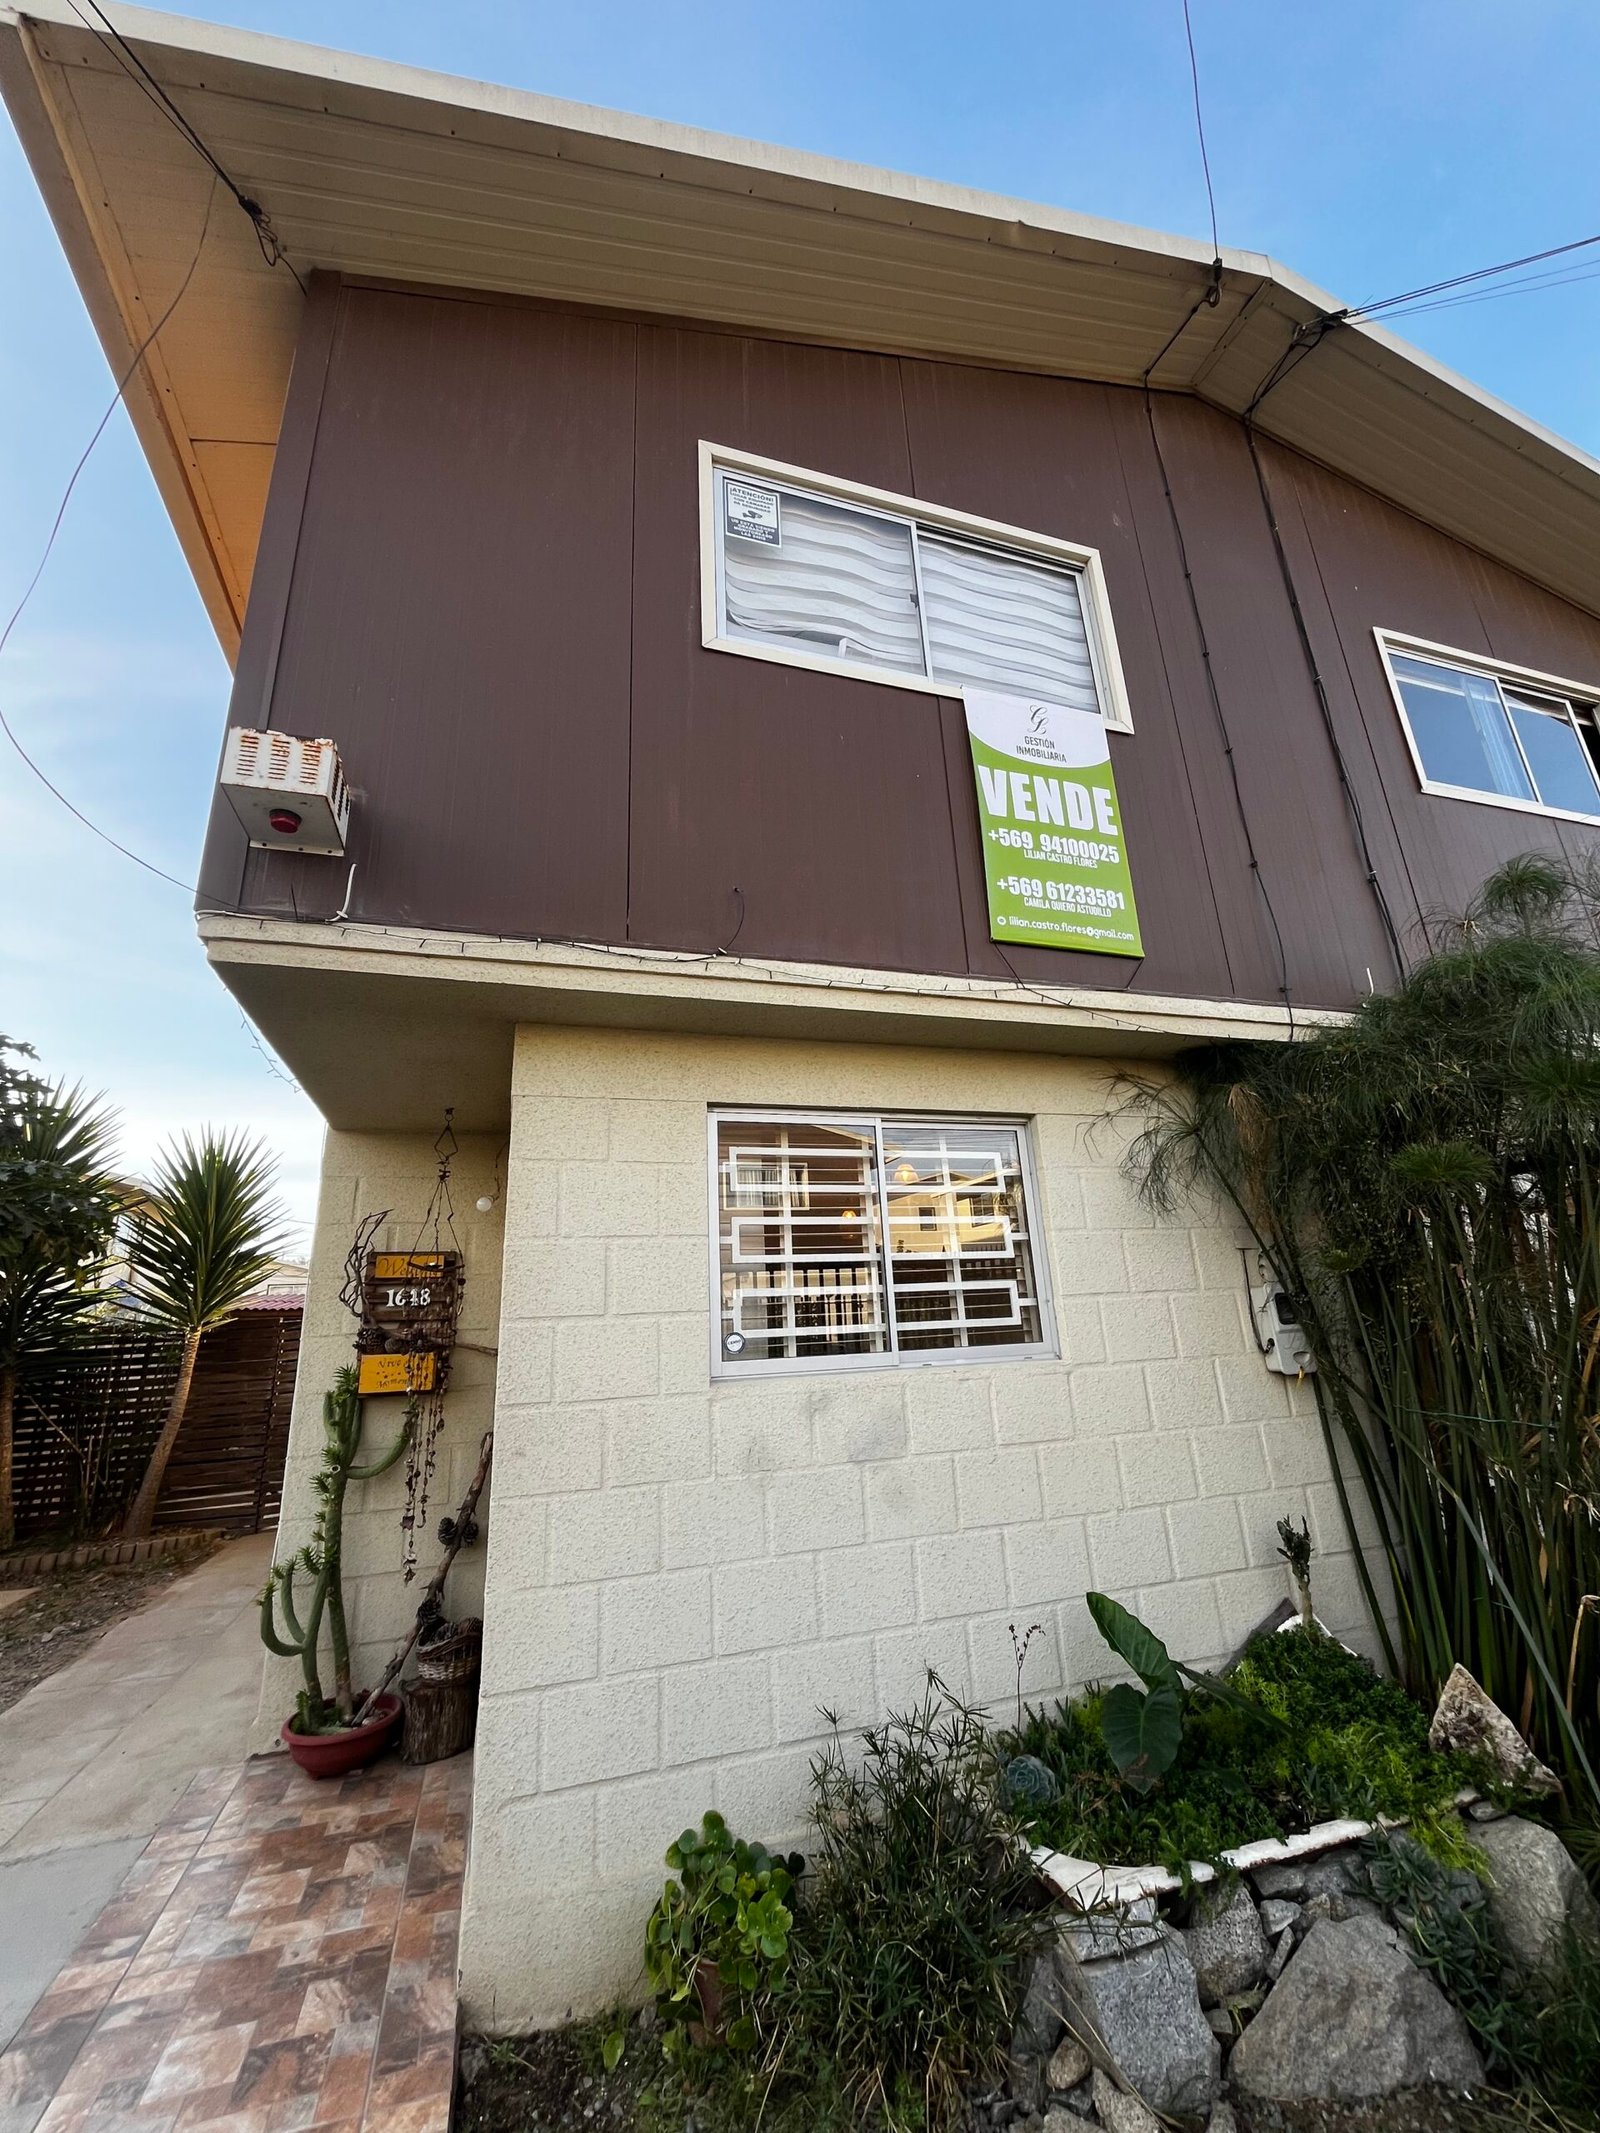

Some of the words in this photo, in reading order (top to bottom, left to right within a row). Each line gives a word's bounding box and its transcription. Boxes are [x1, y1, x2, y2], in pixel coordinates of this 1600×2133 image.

[1025, 736, 1055, 749] GESTIÓN
[1016, 746, 1067, 763] INMOBILIARIA
[978, 765, 1118, 835] VENDE
[989, 828, 1033, 849] +569
[1040, 834, 1119, 863] 94100025
[1024, 850, 1046, 860] LILIAN
[1047, 853, 1072, 865] CASTRO
[1074, 857, 1098, 869] FLORES
[997, 876, 1043, 898] +569
[1046, 881, 1125, 910] 61233581
[1024, 897, 1050, 910] CAMILA
[1077, 904, 1112, 917] ASTUDILLO
[1009, 916, 1134, 940] lilian.castro.flores@gmail.com
